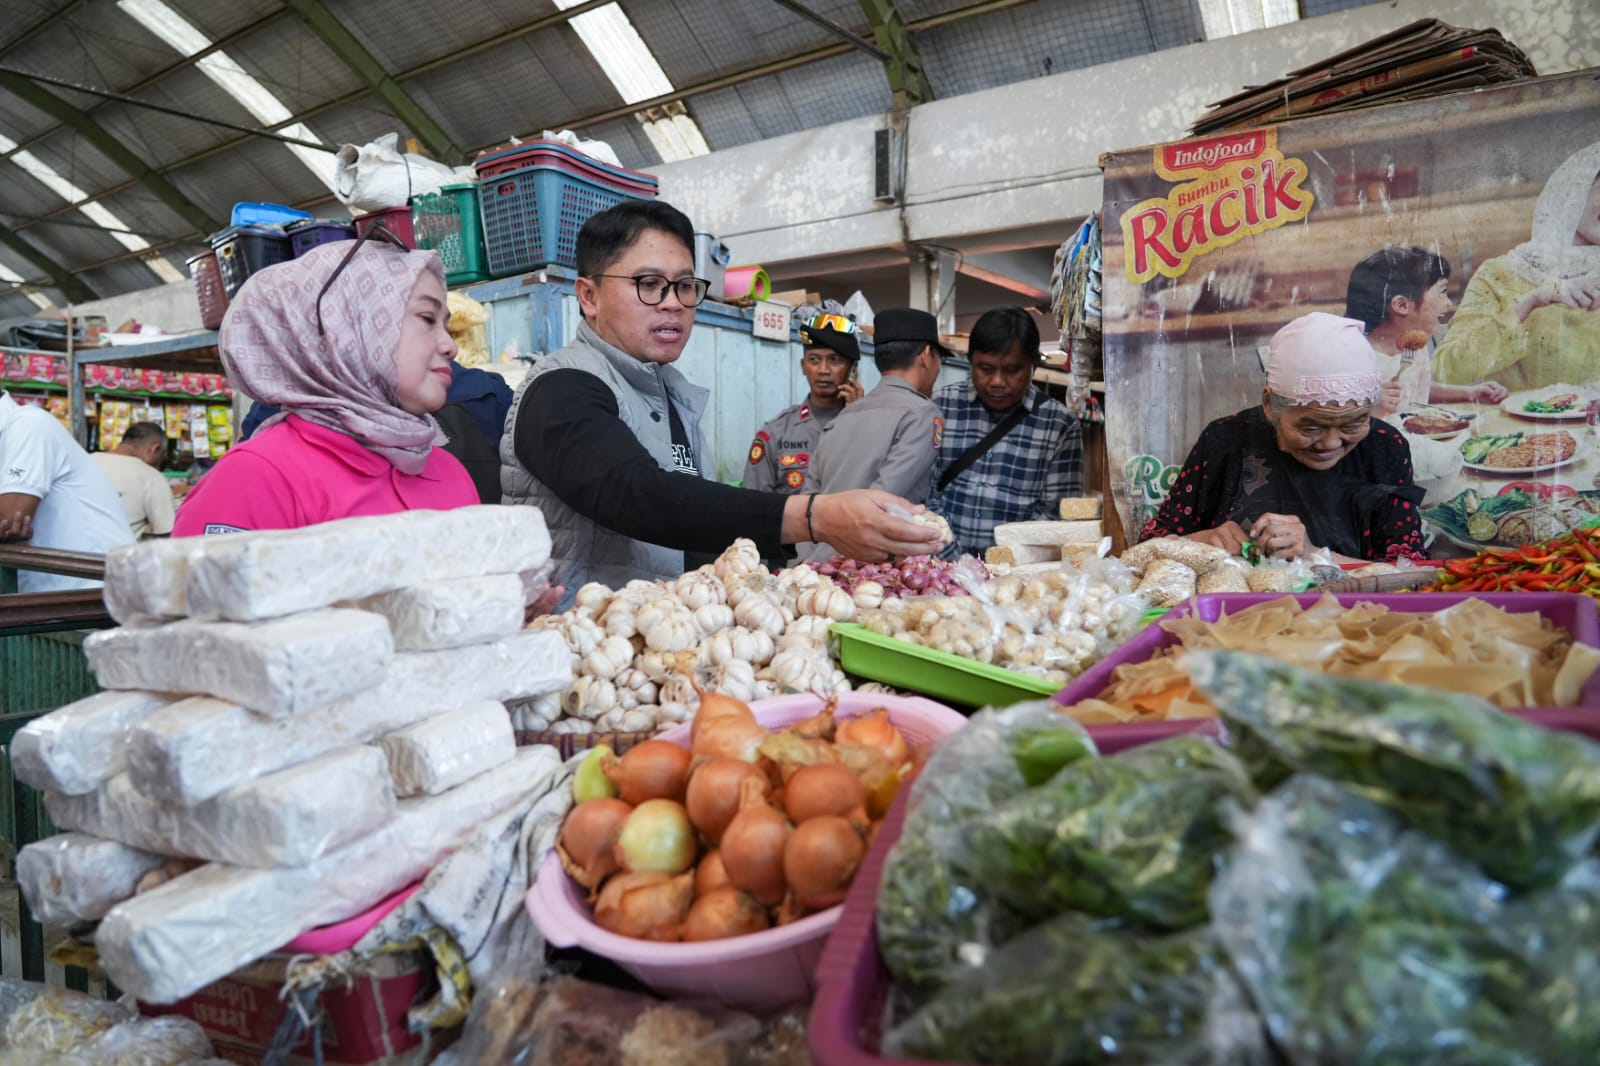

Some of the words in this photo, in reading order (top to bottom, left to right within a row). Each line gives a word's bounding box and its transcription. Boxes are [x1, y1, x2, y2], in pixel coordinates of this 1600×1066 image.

[1174, 138, 1256, 166] Indofood
[1178, 177, 1230, 207] Bumbu
[1130, 159, 1303, 275] Racik
[763, 312, 783, 331] 655
